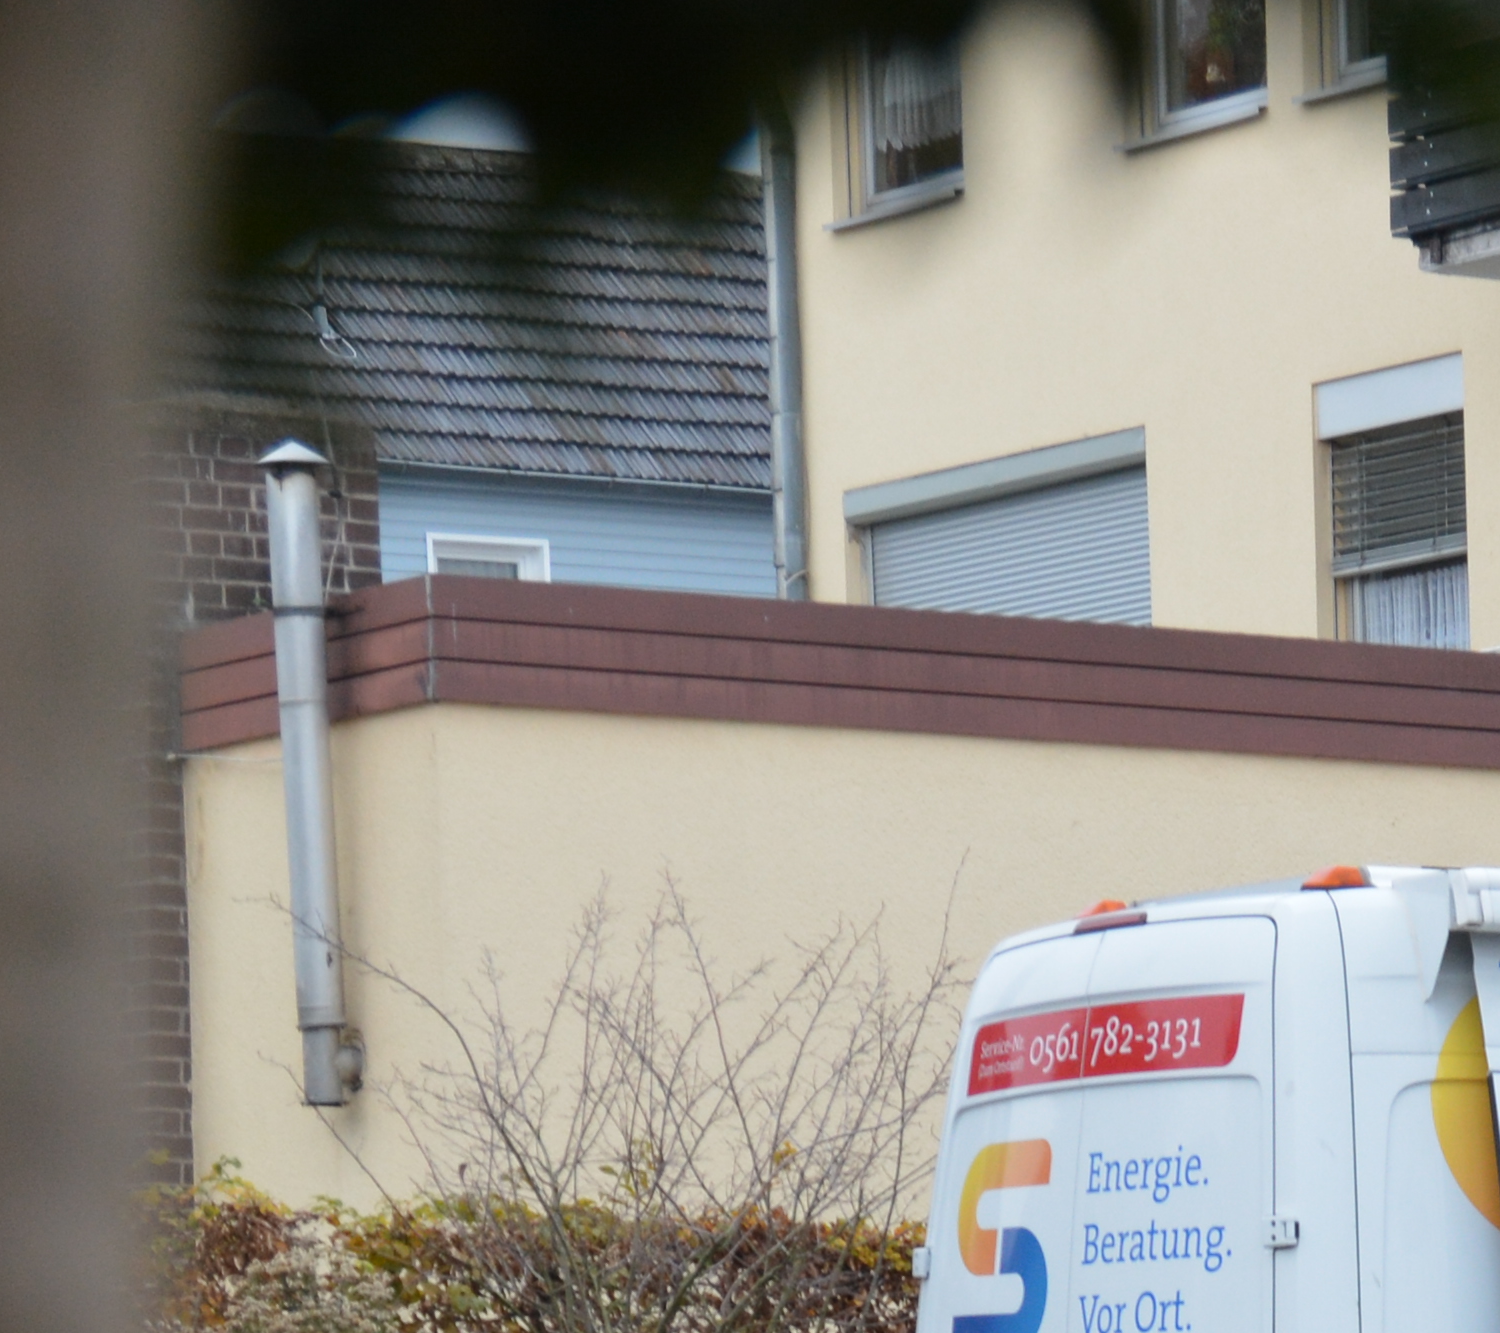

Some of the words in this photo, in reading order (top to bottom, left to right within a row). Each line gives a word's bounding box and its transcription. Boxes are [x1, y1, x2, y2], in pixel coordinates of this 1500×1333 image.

[1030, 1022, 1079, 1073] 0561
[1090, 1015, 1202, 1068] 782-3131
[1086, 1144, 1208, 1203] Energie.
[1081, 1219, 1232, 1273] Beratung.
[1134, 1289, 1192, 1333] Ort.
